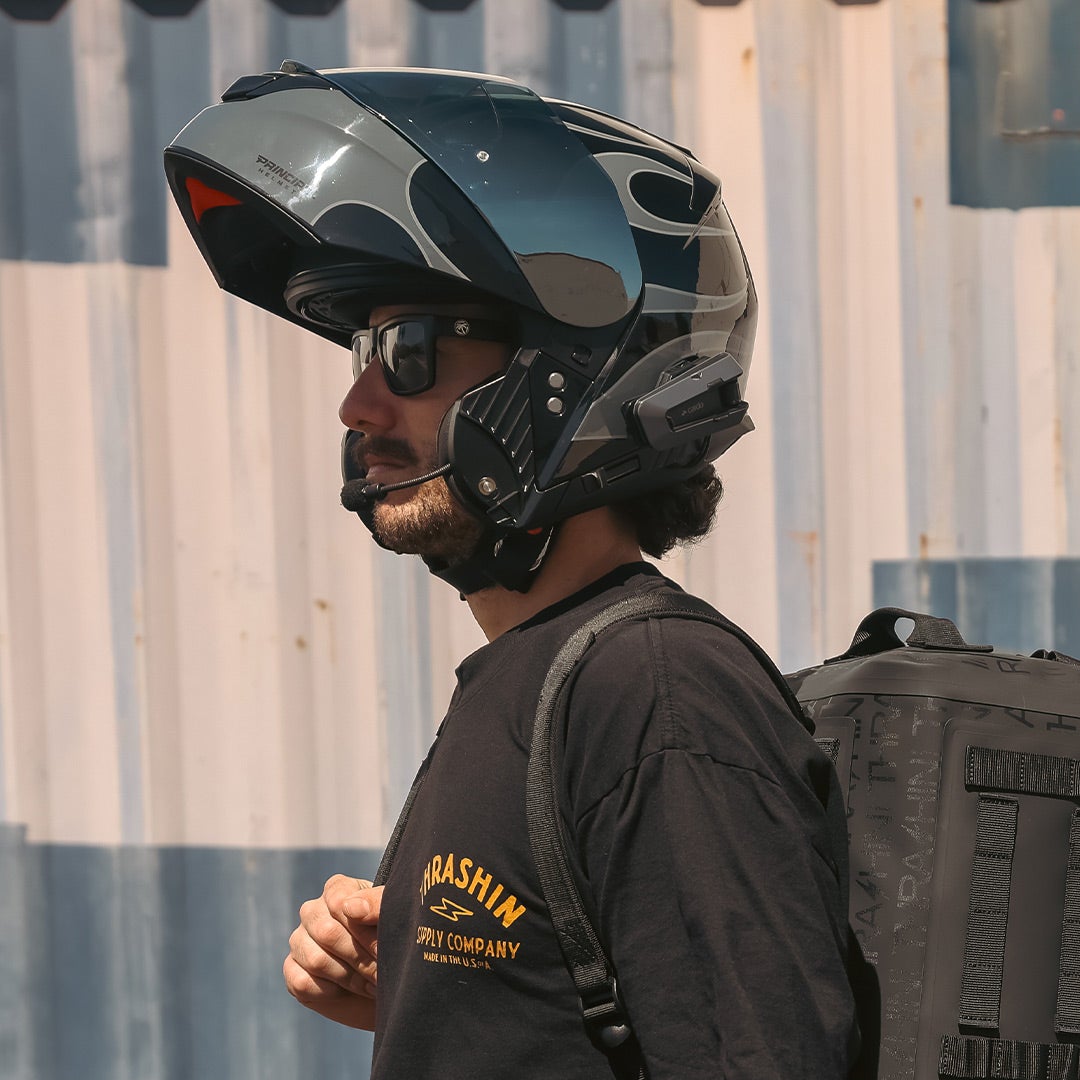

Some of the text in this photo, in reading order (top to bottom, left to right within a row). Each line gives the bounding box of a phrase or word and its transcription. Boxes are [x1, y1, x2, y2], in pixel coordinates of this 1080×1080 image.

[419, 853, 527, 928] THRASHIN
[423, 951, 440, 963] MADE
[440, 954, 448, 964] IN
[448, 955, 462, 965] THE
[447, 932, 521, 960] COMPANY
